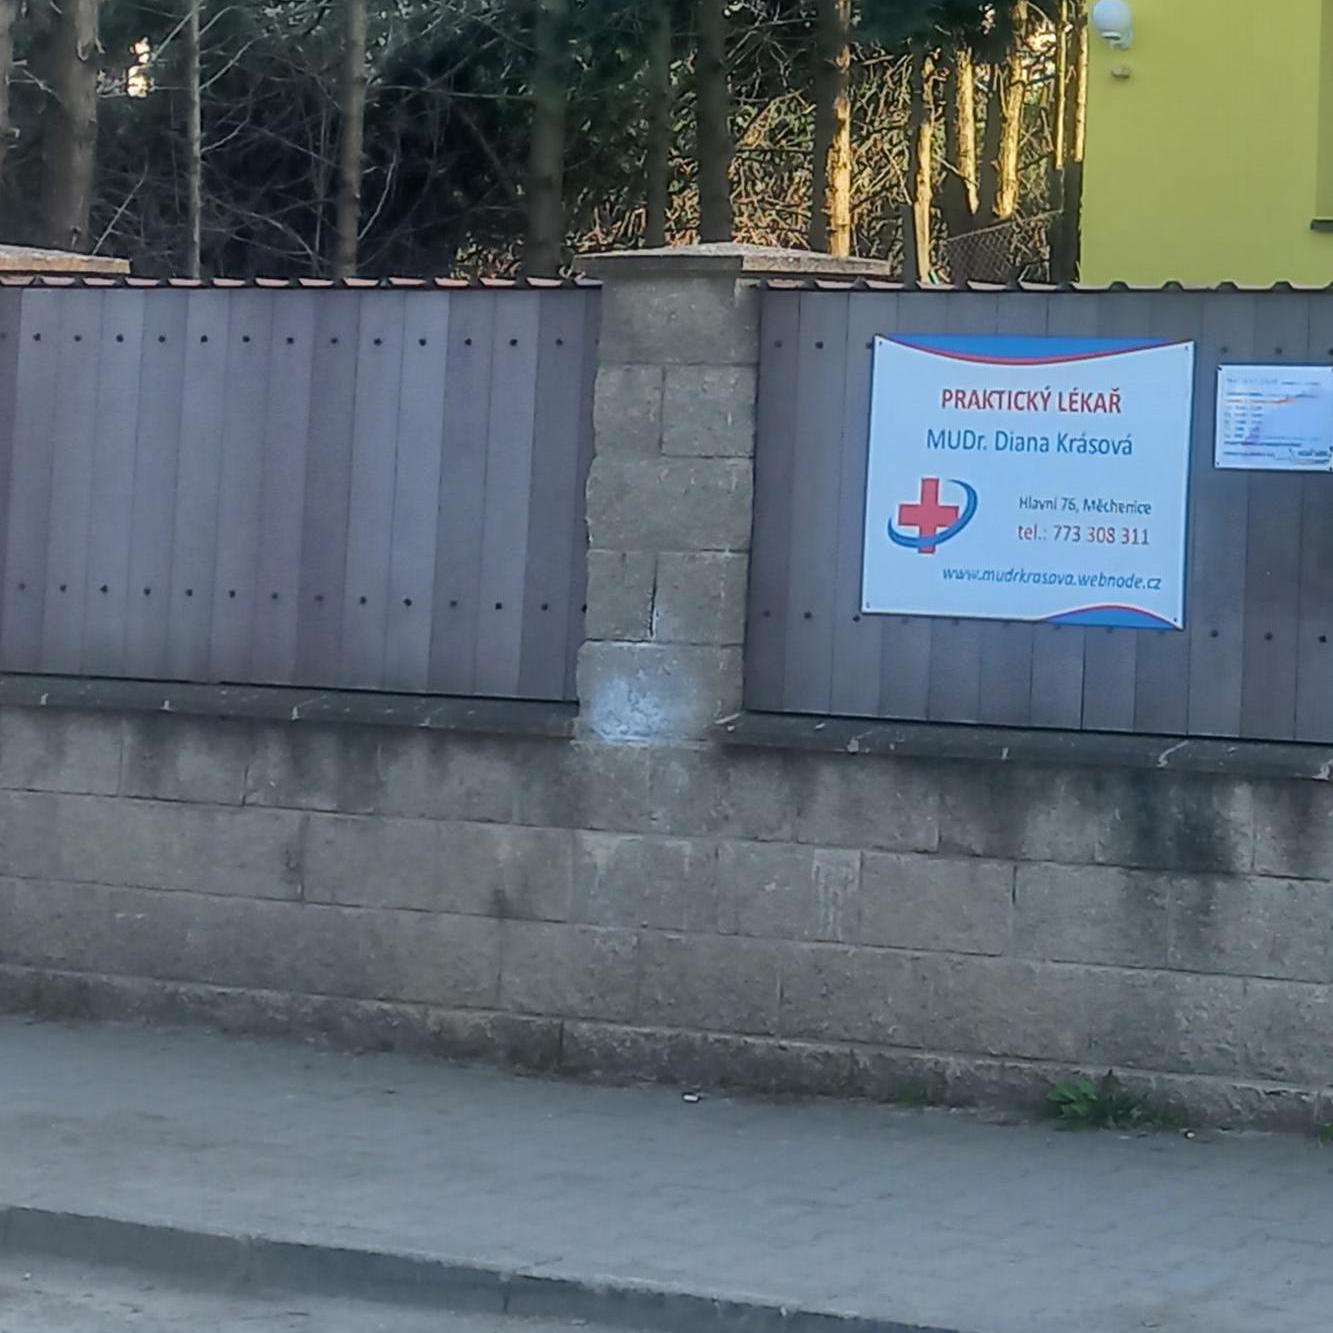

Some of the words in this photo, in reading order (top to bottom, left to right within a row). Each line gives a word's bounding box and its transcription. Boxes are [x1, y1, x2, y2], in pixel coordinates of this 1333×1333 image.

[942, 385, 1051, 412] PRAKTICKÝ
[1058, 387, 1121, 414] LÉKAŘ
[926, 428, 987, 451] MUDr.
[995, 430, 1049, 453] Diana
[1056, 432, 1132, 455] Krásová
[1018, 496, 1057, 511] Hlavní
[1083, 498, 1152, 515] Měchenice
[1017, 523, 1047, 541] tel.:
[1053, 525, 1081, 542] 773
[1087, 526, 1115, 544] 308
[1121, 528, 1149, 545] 311
[942, 567, 1161, 590] www.mudrkrasova.webnode.cz
